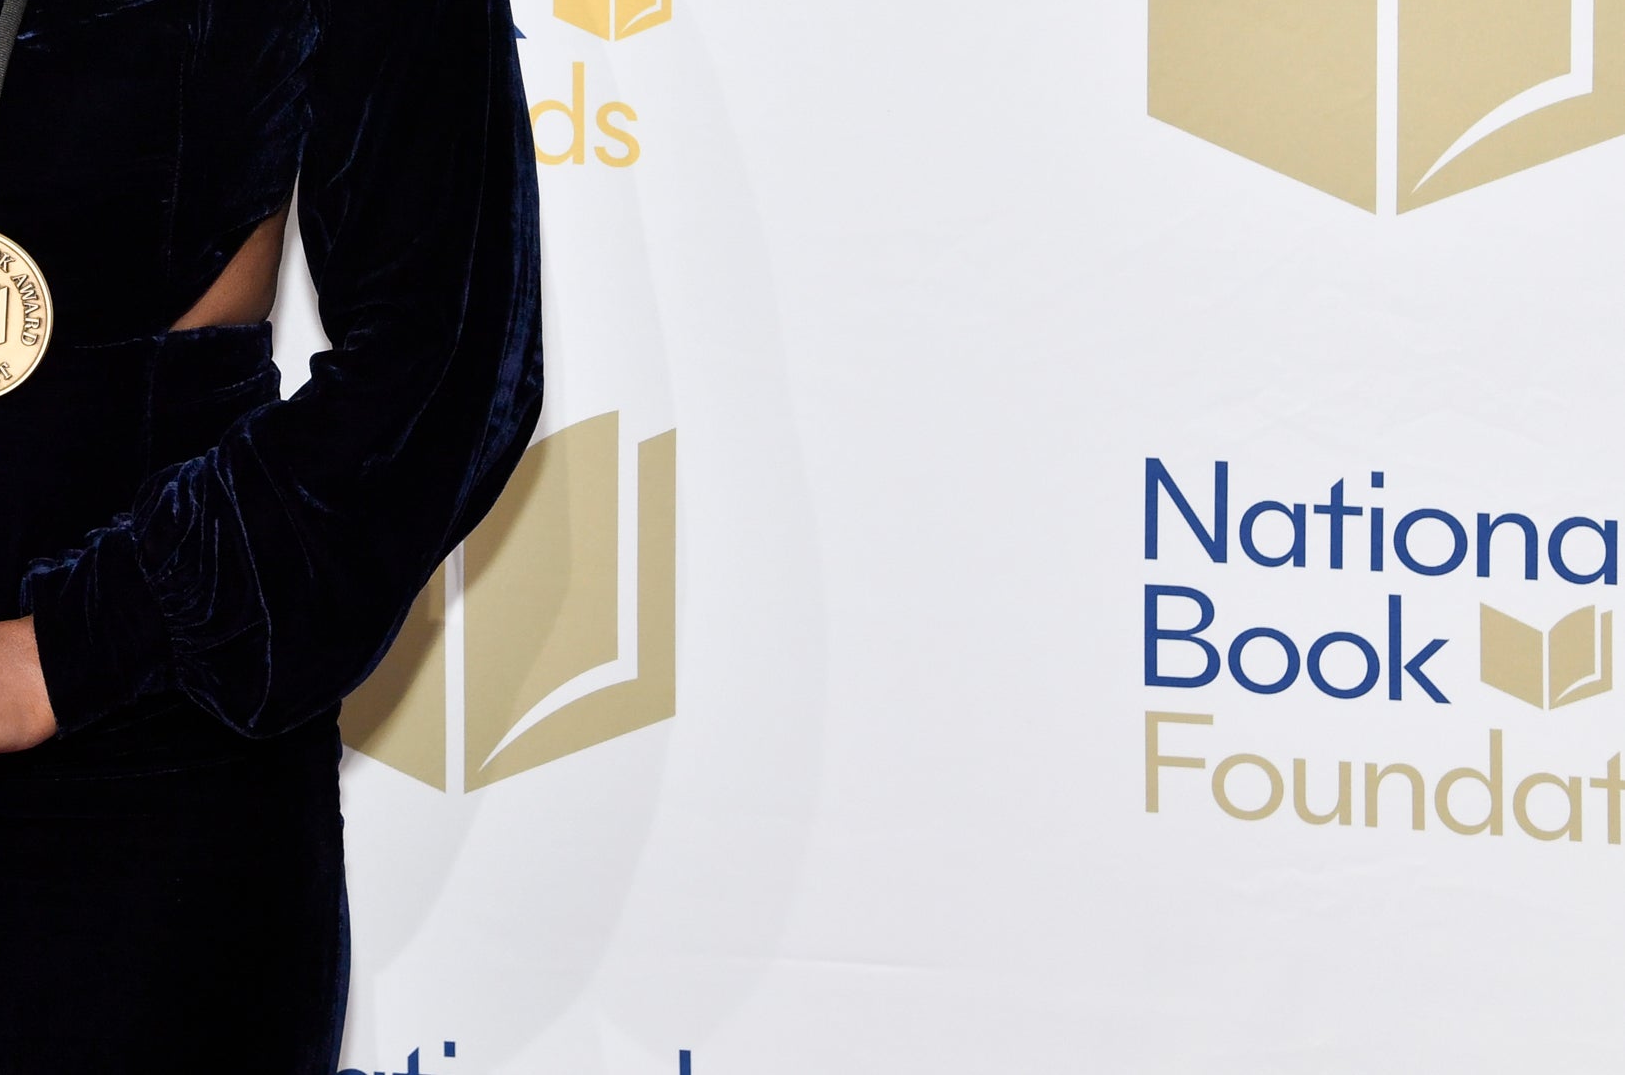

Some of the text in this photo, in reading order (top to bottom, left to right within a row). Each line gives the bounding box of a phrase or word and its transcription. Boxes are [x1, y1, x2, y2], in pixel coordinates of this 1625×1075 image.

[11, 273, 42, 346] AWARD
[1144, 457, 1618, 585] Nationa
[1144, 584, 1452, 704] Book
